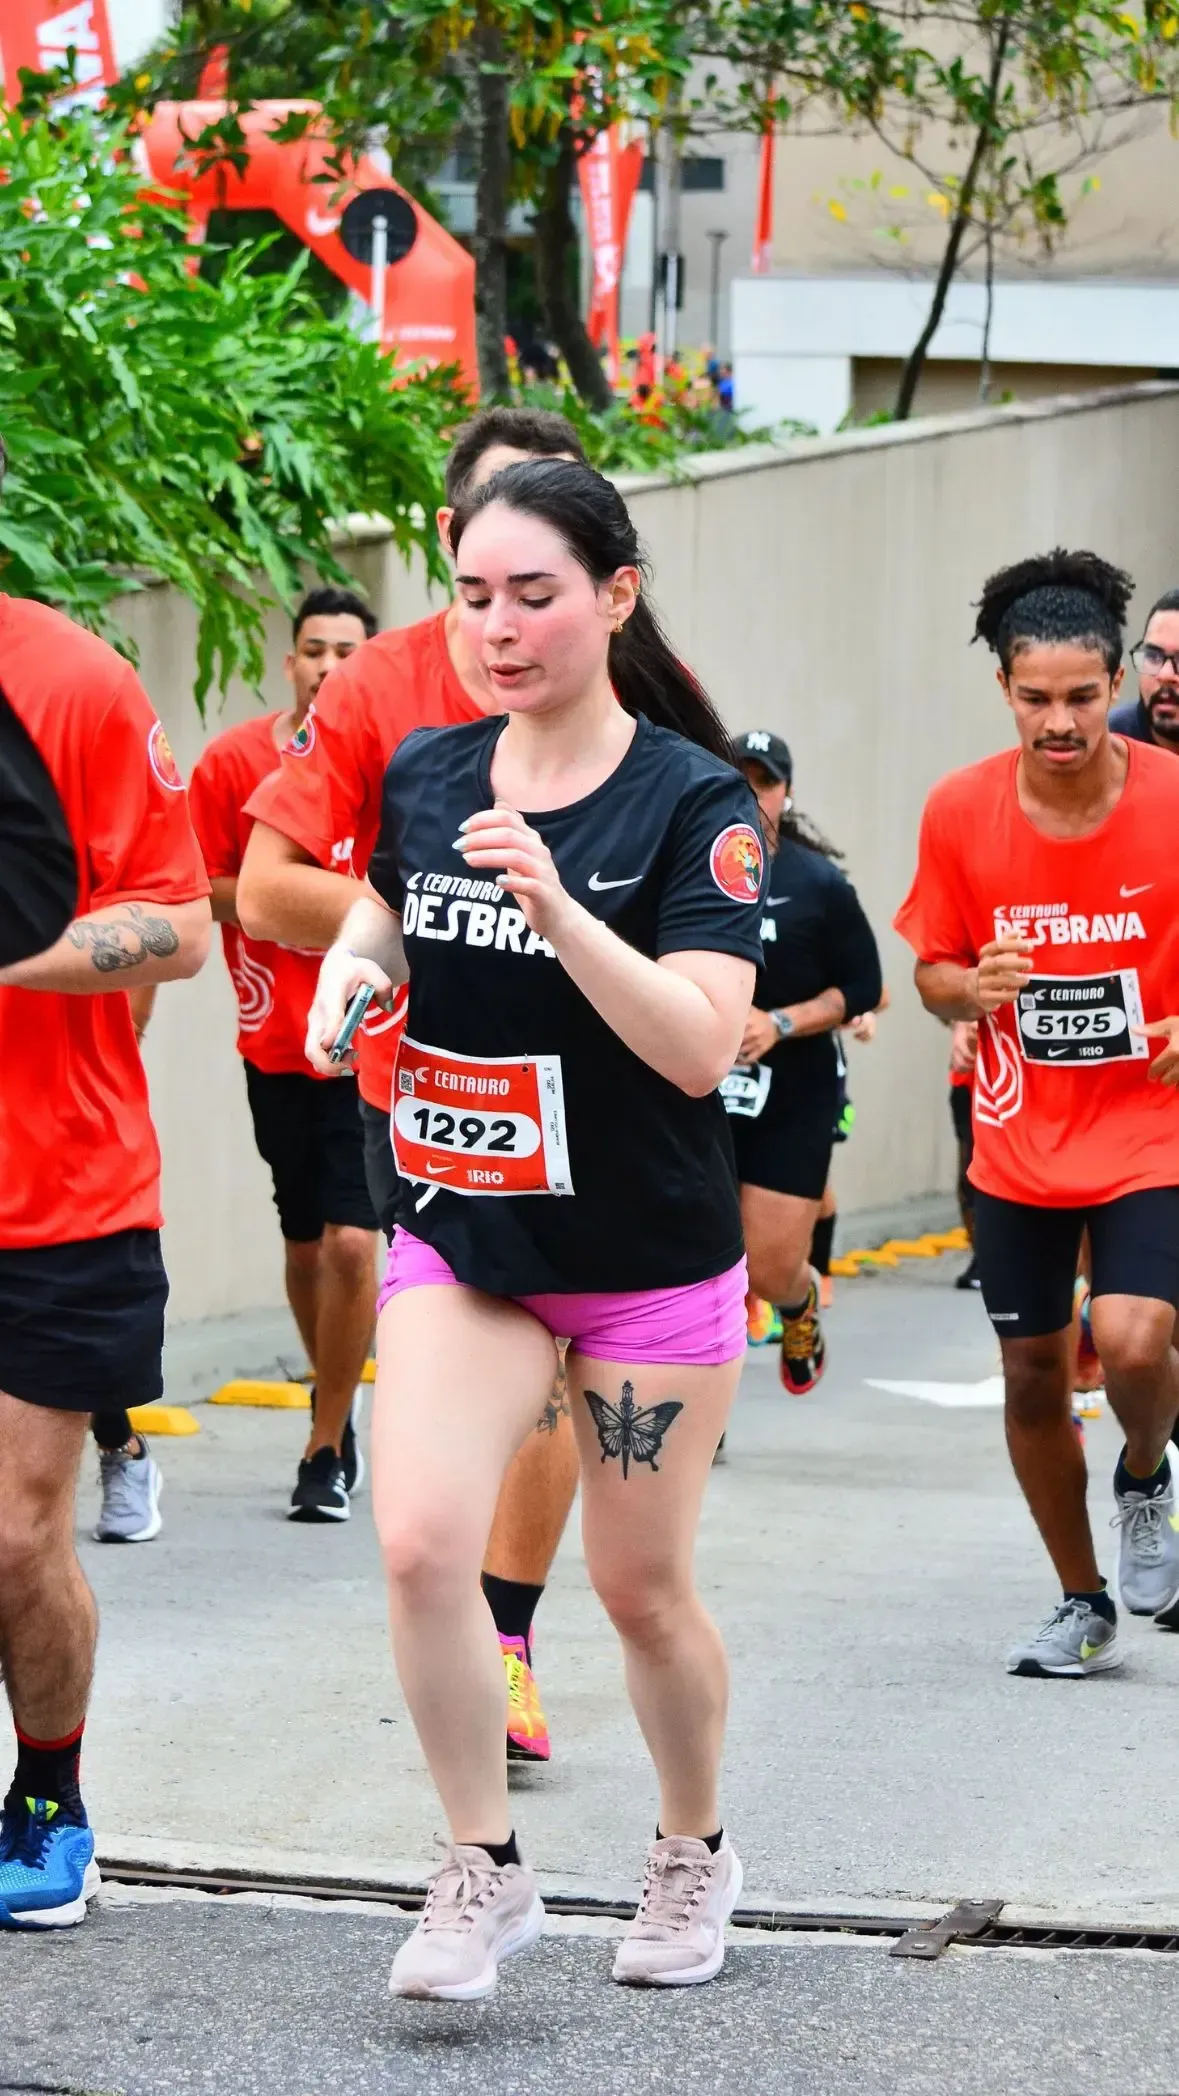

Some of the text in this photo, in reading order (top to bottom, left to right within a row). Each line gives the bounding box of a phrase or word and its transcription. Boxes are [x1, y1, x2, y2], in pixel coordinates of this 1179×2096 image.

[422, 872, 505, 903] CENTAURO
[1010, 902, 1068, 918] CENTAURO
[402, 892, 557, 959] DESBRA
[993, 911, 1147, 946] DESBRAVA
[1050, 986, 1105, 1002] CENTAURO
[1035, 1011, 1110, 1036] 5195
[434, 1069, 510, 1096] CENTAURO
[413, 1107, 517, 1152] 1292
